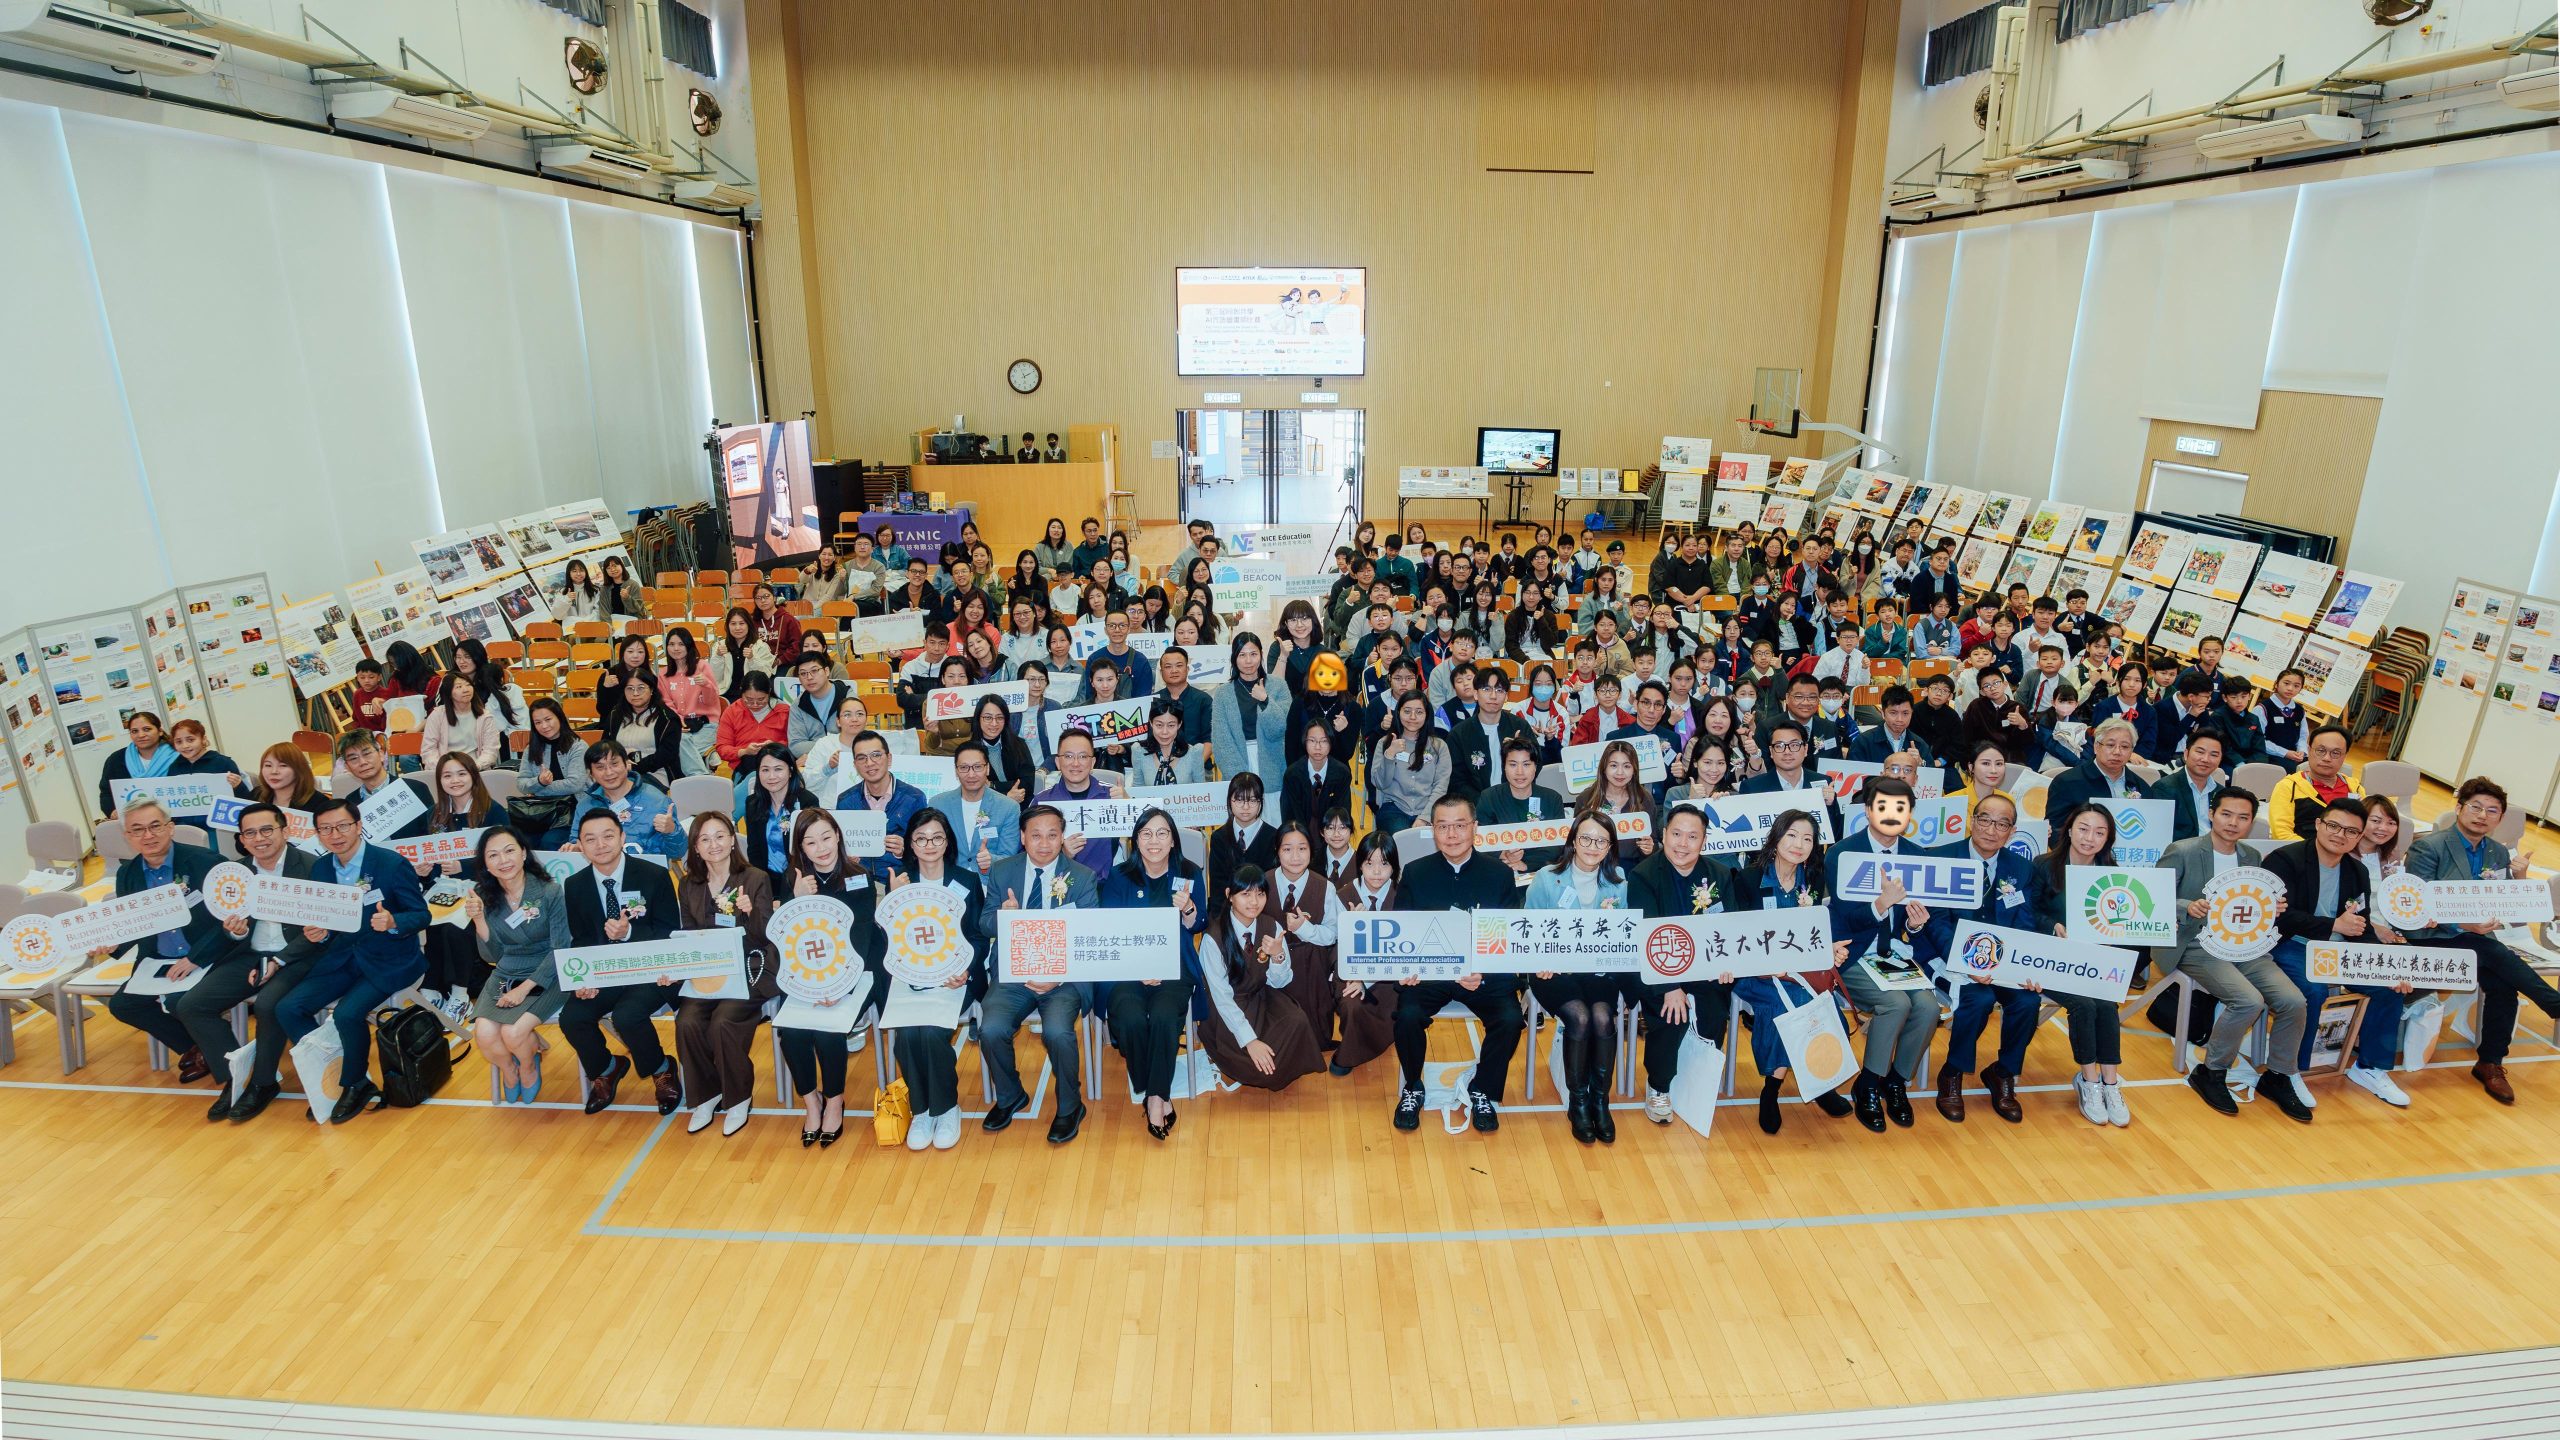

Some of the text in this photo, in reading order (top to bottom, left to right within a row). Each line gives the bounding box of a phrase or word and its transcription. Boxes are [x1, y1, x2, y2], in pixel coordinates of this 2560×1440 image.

[1303, 394, 1321, 402] EXIT
[896, 531, 941, 542] TANIC
[1261, 532, 1311, 543] NICE Education
[1244, 574, 1282, 582] BEACON
[1216, 590, 1258, 600] mLang
[1636, 740, 1655, 752] 碼港
[154, 785, 209, 797] 香港教育城
[1173, 793, 1211, 805] United
[846, 828, 883, 837] ORANGE
[846, 840, 872, 849] NEWS
[1701, 840, 1725, 851] UNG
[1726, 838, 1758, 850] WING
[2112, 847, 2161, 863] 國移動
[2126, 921, 2170, 932] HKWEA
[1073, 935, 1168, 947] 蔡德允女士教學及
[1511, 942, 1639, 955] The Y.Elites Association
[1073, 950, 1121, 962] 研究基金
[1350, 956, 1461, 964] Internet Professional Association
[1595, 957, 1639, 968] 教育研究會
[1349, 966, 1462, 976] 互聯網專業協會
[2342, 970, 2473, 985] Hong Kong Chinese Culture Development Association
